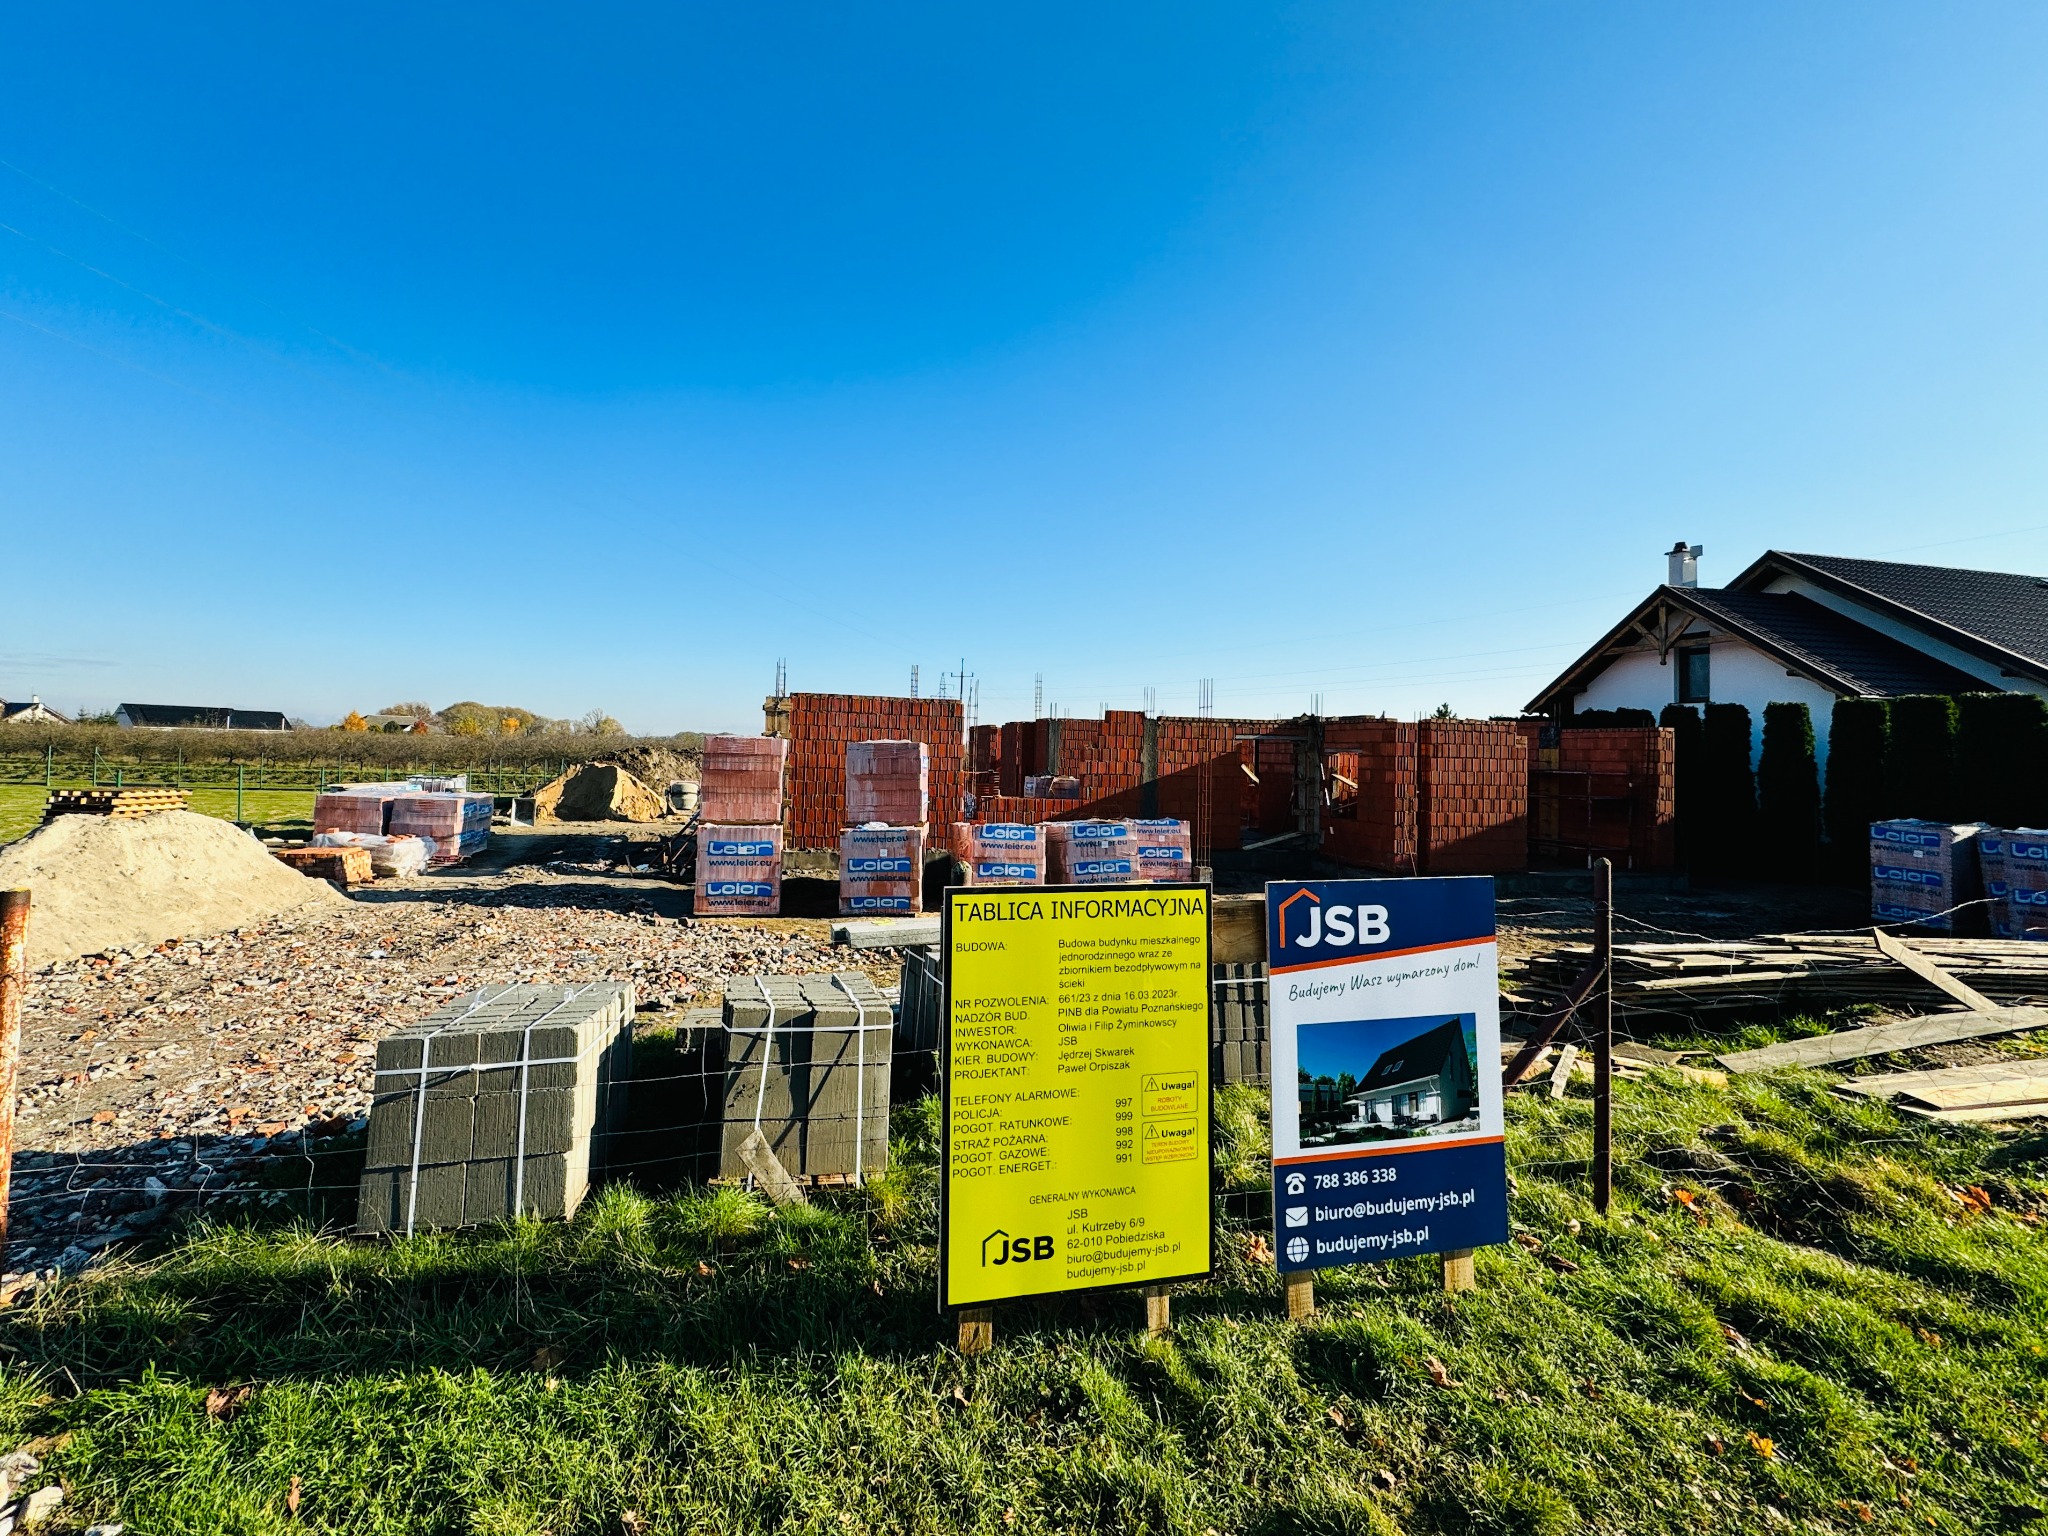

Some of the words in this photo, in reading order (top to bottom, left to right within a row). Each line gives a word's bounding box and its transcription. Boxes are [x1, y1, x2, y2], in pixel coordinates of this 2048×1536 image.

[982, 825, 1036, 840] Leier
[1074, 824, 1126, 838] Leier
[1870, 827, 1940, 846] Leier
[853, 835, 909, 843] www.leier.eu
[980, 842, 1037, 851] www.leier.eu
[708, 859, 773, 867] www.leier.eu
[849, 859, 911, 871] Leier
[1074, 862, 1130, 875] Leier
[979, 864, 1036, 877] Leier
[1874, 866, 1941, 884] Leier
[707, 883, 772, 896] Leier
[708, 899, 771, 908] www.leier.eu
[851, 898, 910, 908] Leier
[955, 902, 1044, 922] TABLICA
[1051, 898, 1204, 919] INFORMACYJNA
[1295, 904, 1391, 948] JSB
[955, 942, 1007, 952] BUDOWA:
[1058, 939, 1096, 949] Budowa
[1099, 937, 1138, 949] budynku
[1140, 936, 1201, 947] mieszkalnego
[1059, 951, 1136, 964] jednorodzinnego
[1138, 950, 1160, 959] wraz
[1162, 950, 1173, 958] ze
[1059, 964, 1112, 975] zbiornikiem
[1114, 962, 1188, 974] bezodpływowym
[1190, 961, 1201, 969] na
[1059, 979, 1085, 989] ścieki
[1288, 979, 1346, 1002] Budujemy
[1350, 974, 1383, 991] Wasz
[1386, 964, 1450, 985] wymarzony
[1453, 953, 1481, 974] dom!
[955, 999, 972, 1009] NR
[974, 996, 1049, 1008] POZWOLENIA:
[1058, 993, 1091, 1004] 661/23
[1093, 994, 1099, 1002] z
[1102, 991, 1121, 1001] dnia
[1125, 988, 1180, 1000] 16.03.2023r.
[1058, 1007, 1083, 1018] PINB
[1086, 1005, 1100, 1016] dla
[1102, 1004, 1140, 1015] Powiatu
[1142, 1001, 1205, 1013] Poznańskiego
[955, 1010, 1002, 1024] NADZÓR
[955, 1025, 1017, 1038] INWESTOR:
[1058, 1022, 1087, 1033] Oliwia
[1095, 1019, 1115, 1031] Filip
[1117, 1017, 1179, 1031] Żyminkowscy
[955, 1038, 1033, 1052] WYKONAWCA:
[1058, 1036, 1078, 1047] JSB
[954, 1054, 984, 1066] KIER.
[986, 1051, 1039, 1064] BUDOWY:
[1058, 1049, 1093, 1062] Jędrzej
[1095, 1047, 1136, 1059] Skwarek
[954, 1066, 1030, 1081] PROJEKTANT:
[1057, 1063, 1087, 1074] Paweł
[1089, 1060, 1131, 1072] Orpiszak
[1161, 1080, 1196, 1091] Uwaga!
[954, 1092, 1012, 1107] TELEFONY
[1014, 1088, 1080, 1102] ALARMOWE:
[1115, 1097, 1133, 1108] 997
[954, 1108, 1003, 1121] POLICJA:
[1115, 1111, 1133, 1122] 999
[953, 1122, 997, 1135] POGOT.
[999, 1116, 1073, 1131] RATUNKOWE:
[1115, 1126, 1134, 1137] 998
[1161, 1127, 1196, 1138] Uwaga!
[953, 1137, 990, 1151] STRAŻ
[993, 1134, 1049, 1147] POŻARNA:
[1115, 1140, 1134, 1151] 992
[953, 1151, 997, 1165] POGOT.
[999, 1147, 1051, 1161] GAZOWE:
[1115, 1153, 1133, 1164] 991
[953, 1165, 997, 1179] POGOT.
[1313, 1174, 1340, 1190] 788
[1342, 1170, 1368, 1187] 386
[1371, 1167, 1398, 1184] 338
[1029, 1191, 1080, 1205] GENERALNY
[1081, 1186, 1136, 1200] WYKONAWCA
[1315, 1188, 1475, 1222] biuro@budujemy-jsb.pl
[1067, 1208, 1089, 1220] JSB
[1066, 1222, 1079, 1235] ul.
[1081, 1219, 1127, 1235] Kutrzeby
[1129, 1216, 1145, 1229] 6/9
[1067, 1236, 1104, 1250] 62-010
[1106, 1230, 1165, 1246] Pobiedziska
[1316, 1225, 1429, 1255] budujemy-jsb.pl
[992, 1235, 1055, 1266] JSB
[1066, 1241, 1181, 1265] biuro@budujemy-jsb.pl
[1066, 1260, 1146, 1279] budujemy-jsb.pl
